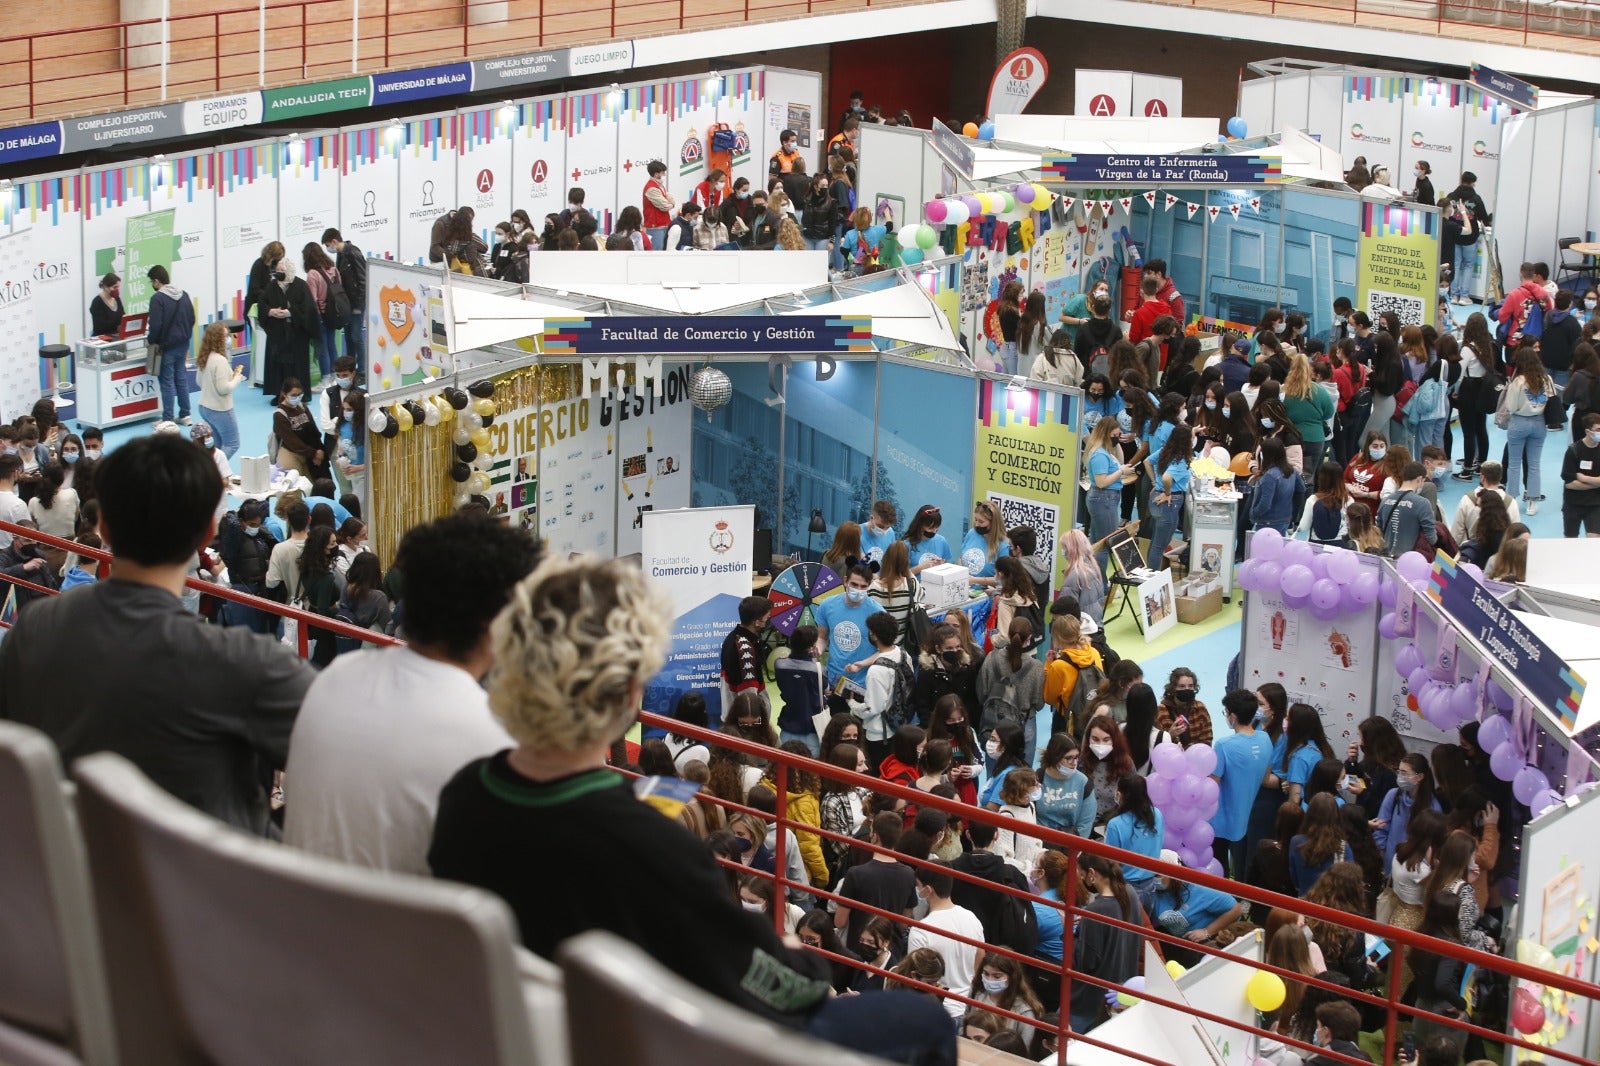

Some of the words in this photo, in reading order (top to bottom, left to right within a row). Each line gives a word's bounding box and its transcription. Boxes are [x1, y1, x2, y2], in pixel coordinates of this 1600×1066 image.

[521, 54, 556, 66] DEPORTIV
[575, 54, 600, 65] JUEGO
[603, 50, 628, 60] LIMPIO
[500, 65, 547, 78] UNIVERSITARIO
[378, 81, 425, 92] UNIVERSIDAD
[426, 77, 436, 86] DE
[437, 73, 466, 84] MÁLAGA
[203, 97, 247, 111] FORMAMOS
[271, 92, 335, 108] ANDALUCIA
[338, 87, 367, 98] TECH
[77, 116, 121, 131] COMPLEJO
[203, 108, 248, 126] EQUIPO
[6, 140, 19, 149] DE
[20, 133, 56, 148] MÁLAGA
[635, 159, 649, 168] Cruz
[1107, 156, 1141, 167] Centro
[1144, 157, 1156, 167] de
[1160, 156, 1217, 167] Enfermería
[583, 168, 598, 176] Cruz
[599, 165, 612, 175] Roja
[1095, 169, 1133, 181] 'Virgen
[1136, 169, 1148, 179] de
[1152, 169, 1161, 179] la
[1165, 169, 1186, 179] Paz'
[1189, 170, 1229, 181] (Ronda)
[409, 206, 446, 219] micampus
[350, 217, 388, 230] micampus
[118, 248, 126, 256] Re
[1376, 244, 1408, 256] CENTRO
[1410, 249, 1421, 258] DE
[1371, 254, 1425, 269] ENFERMERÍA
[129, 264, 154, 281] Res
[1402, 269, 1413, 278] DE
[1416, 272, 1427, 280] LA
[1393, 279, 1421, 291] (Ronda)
[127, 300, 150, 316] trus
[601, 327, 658, 341] Facultad
[663, 328, 679, 341] de
[684, 327, 748, 341] Comercio
[753, 330, 761, 342] y
[766, 326, 816, 340] Gestión
[114, 379, 156, 400] XIOR
[988, 433, 1046, 455] FACULTAD
[1050, 446, 1065, 459] DE
[990, 450, 1061, 476] COMERCIO
[987, 467, 997, 481] Y
[1002, 471, 1062, 495] GESTIÓN
[652, 556, 680, 566] Facultad
[682, 556, 690, 565] de
[652, 565, 698, 577] Comercio
[702, 566, 708, 576] y
[710, 562, 747, 574] Gestión
[712, 621, 741, 629] Marketin
[1471, 586, 1501, 625] Facultad
[1498, 613, 1508, 631] de
[1507, 620, 1541, 663] Psicología
[671, 631, 704, 640] vestigación
[1479, 626, 1487, 641] y
[674, 651, 719, 660] Administración
[676, 673, 705, 681] Dirección
[691, 681, 721, 689] Marketing
